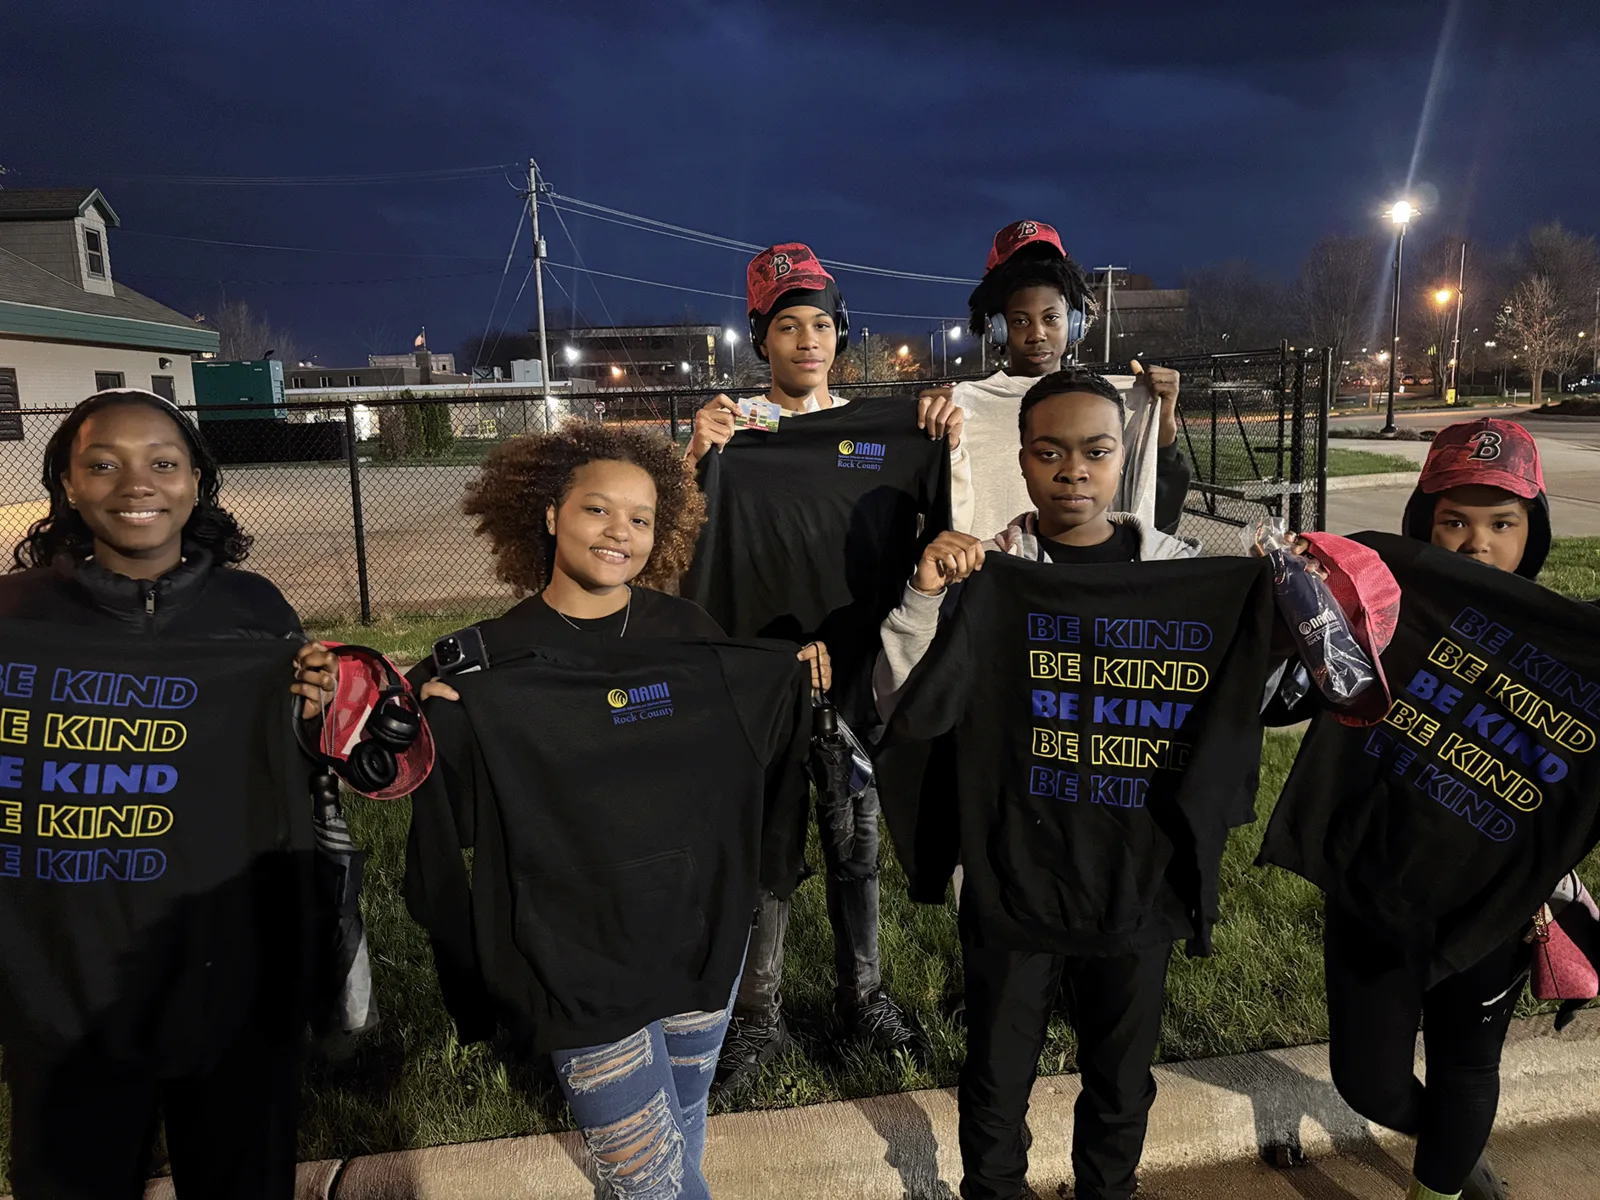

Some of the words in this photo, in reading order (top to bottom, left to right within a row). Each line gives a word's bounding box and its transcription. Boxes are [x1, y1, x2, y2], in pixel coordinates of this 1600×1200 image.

[769, 253, 792, 280] B
[855, 441, 886, 457] NAMI
[1467, 431, 1502, 461] B
[837, 460, 855, 468] Rock
[856, 462, 882, 472] County
[1028, 612, 1081, 644] BE
[1094, 618, 1213, 651] KIND
[1450, 606, 1514, 655] BE
[0, 662, 37, 698] E
[50, 668, 198, 709] KIND
[1029, 650, 1081, 683] BE
[1093, 656, 1209, 692] KIND
[628, 682, 671, 704] NAMI
[1031, 689, 1079, 721] BE
[1427, 637, 1489, 684] BE
[1485, 673, 1597, 753] KIND
[0, 708, 30, 744] E
[44, 713, 187, 752] KIND
[613, 713, 637, 725] Rock
[640, 707, 674, 720] County
[1405, 668, 1464, 714] BE
[1462, 702, 1569, 783] KIND
[1032, 727, 1079, 763] BE
[1383, 699, 1441, 747] BE
[1437, 732, 1543, 812] KIND
[0, 755, 24, 789] E
[41, 761, 178, 794] KIND
[1029, 766, 1079, 802] BE
[1363, 727, 1418, 776] BE
[1414, 763, 1516, 842] KIND
[0, 801, 22, 834] E
[37, 804, 174, 839] KIND
[0, 844, 21, 878] E
[36, 848, 167, 882] KIND
